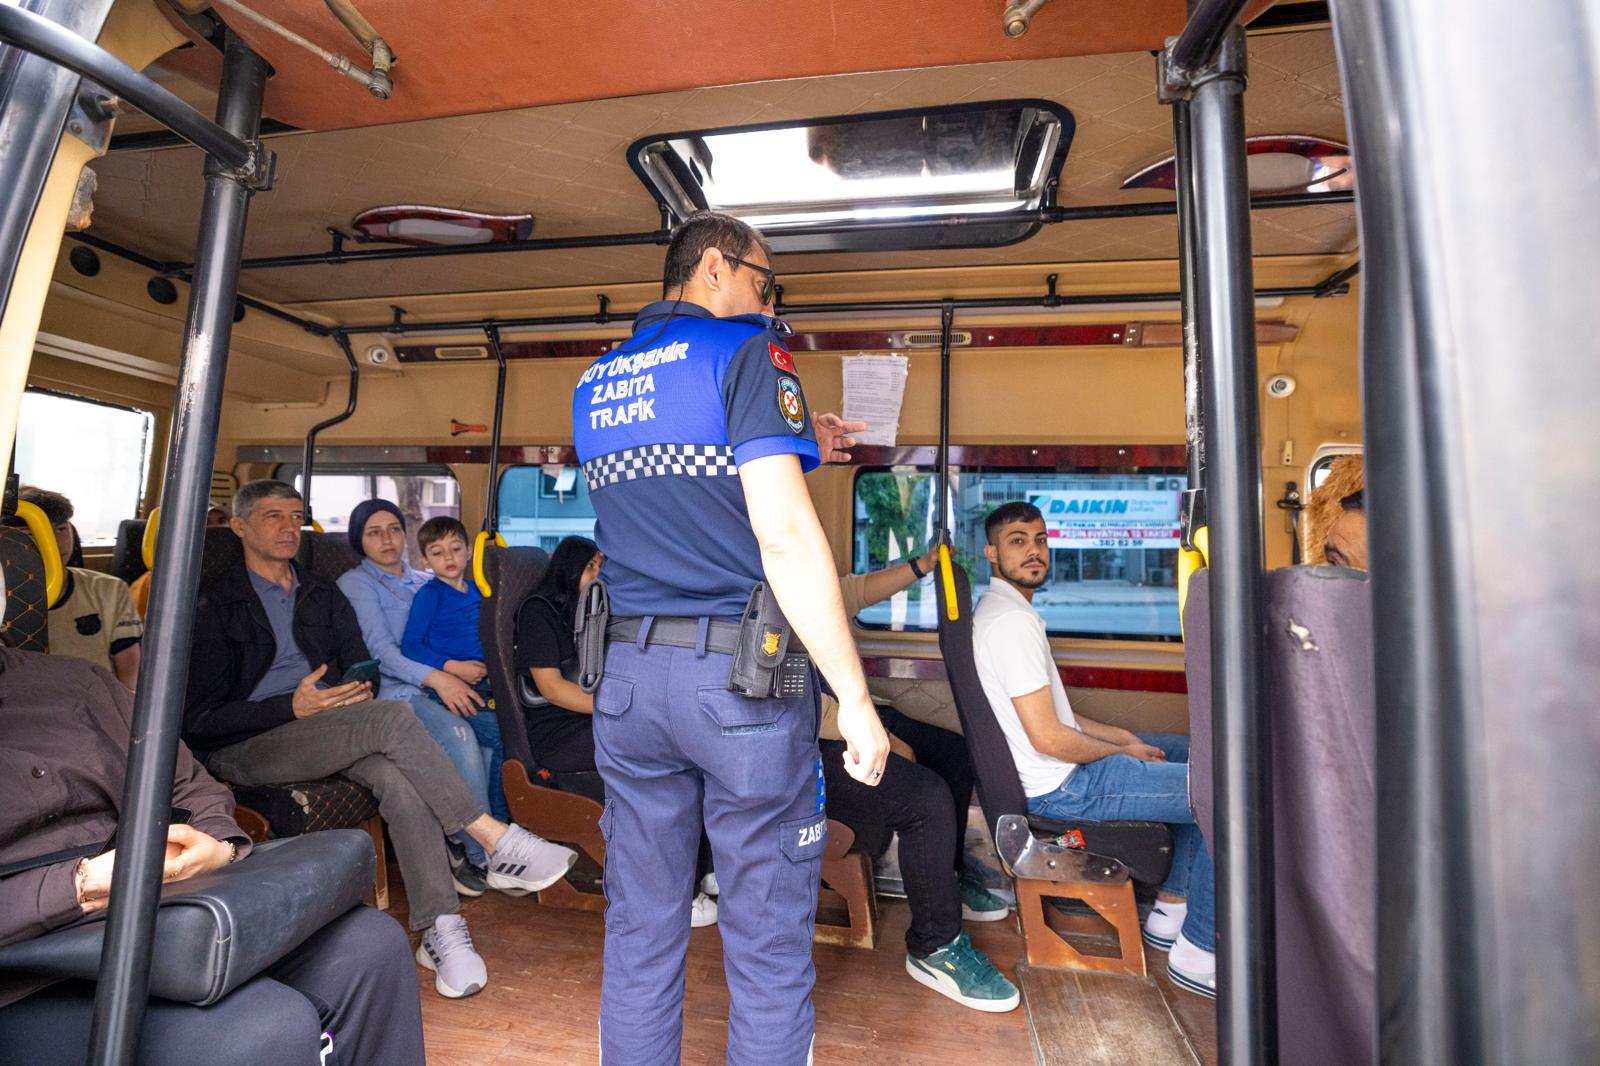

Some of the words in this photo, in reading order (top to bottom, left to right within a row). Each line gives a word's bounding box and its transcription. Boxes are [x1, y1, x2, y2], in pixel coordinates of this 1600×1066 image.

[591, 373, 656, 405] ZABITA
[589, 397, 656, 430] TRAFİK
[1049, 499, 1129, 514] DAIKIN
[798, 819, 827, 847] ZABI
